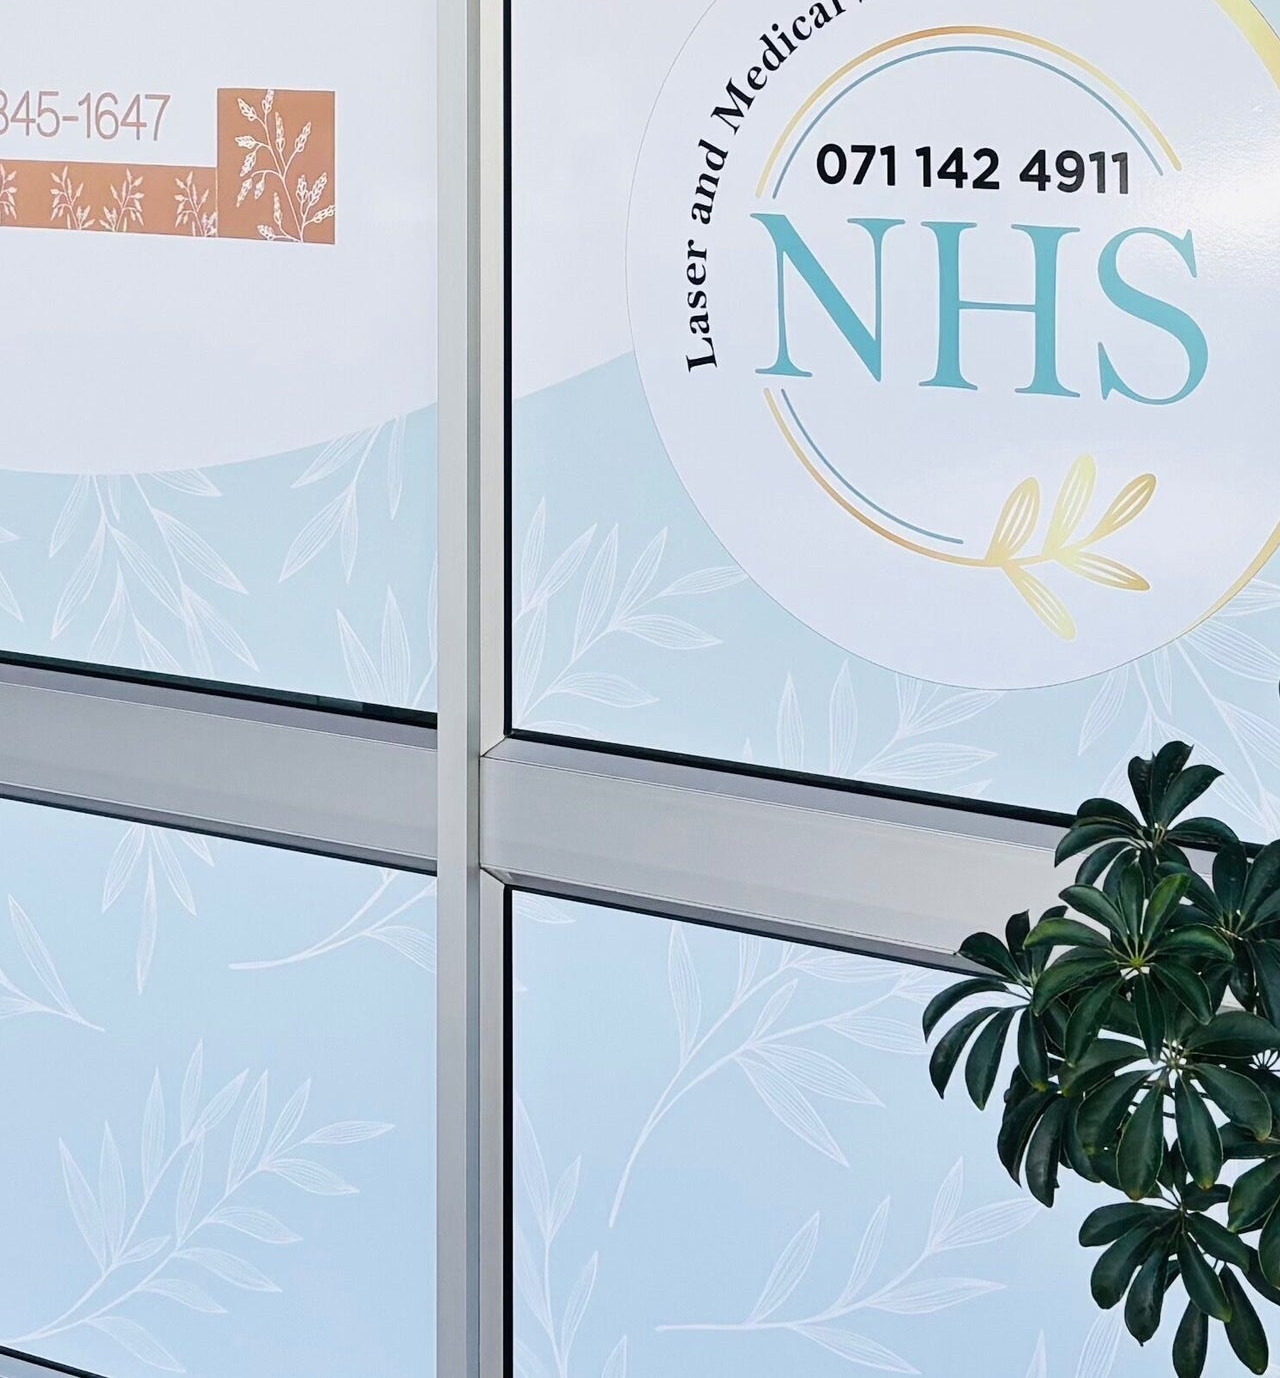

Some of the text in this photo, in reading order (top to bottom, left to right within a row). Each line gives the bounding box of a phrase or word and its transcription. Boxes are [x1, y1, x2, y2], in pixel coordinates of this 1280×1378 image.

[690, 138, 729, 227] and
[815, 142, 1131, 195] 071 142 4911
[685, 238, 719, 374] Laser
[749, 211, 1210, 407] NHS
